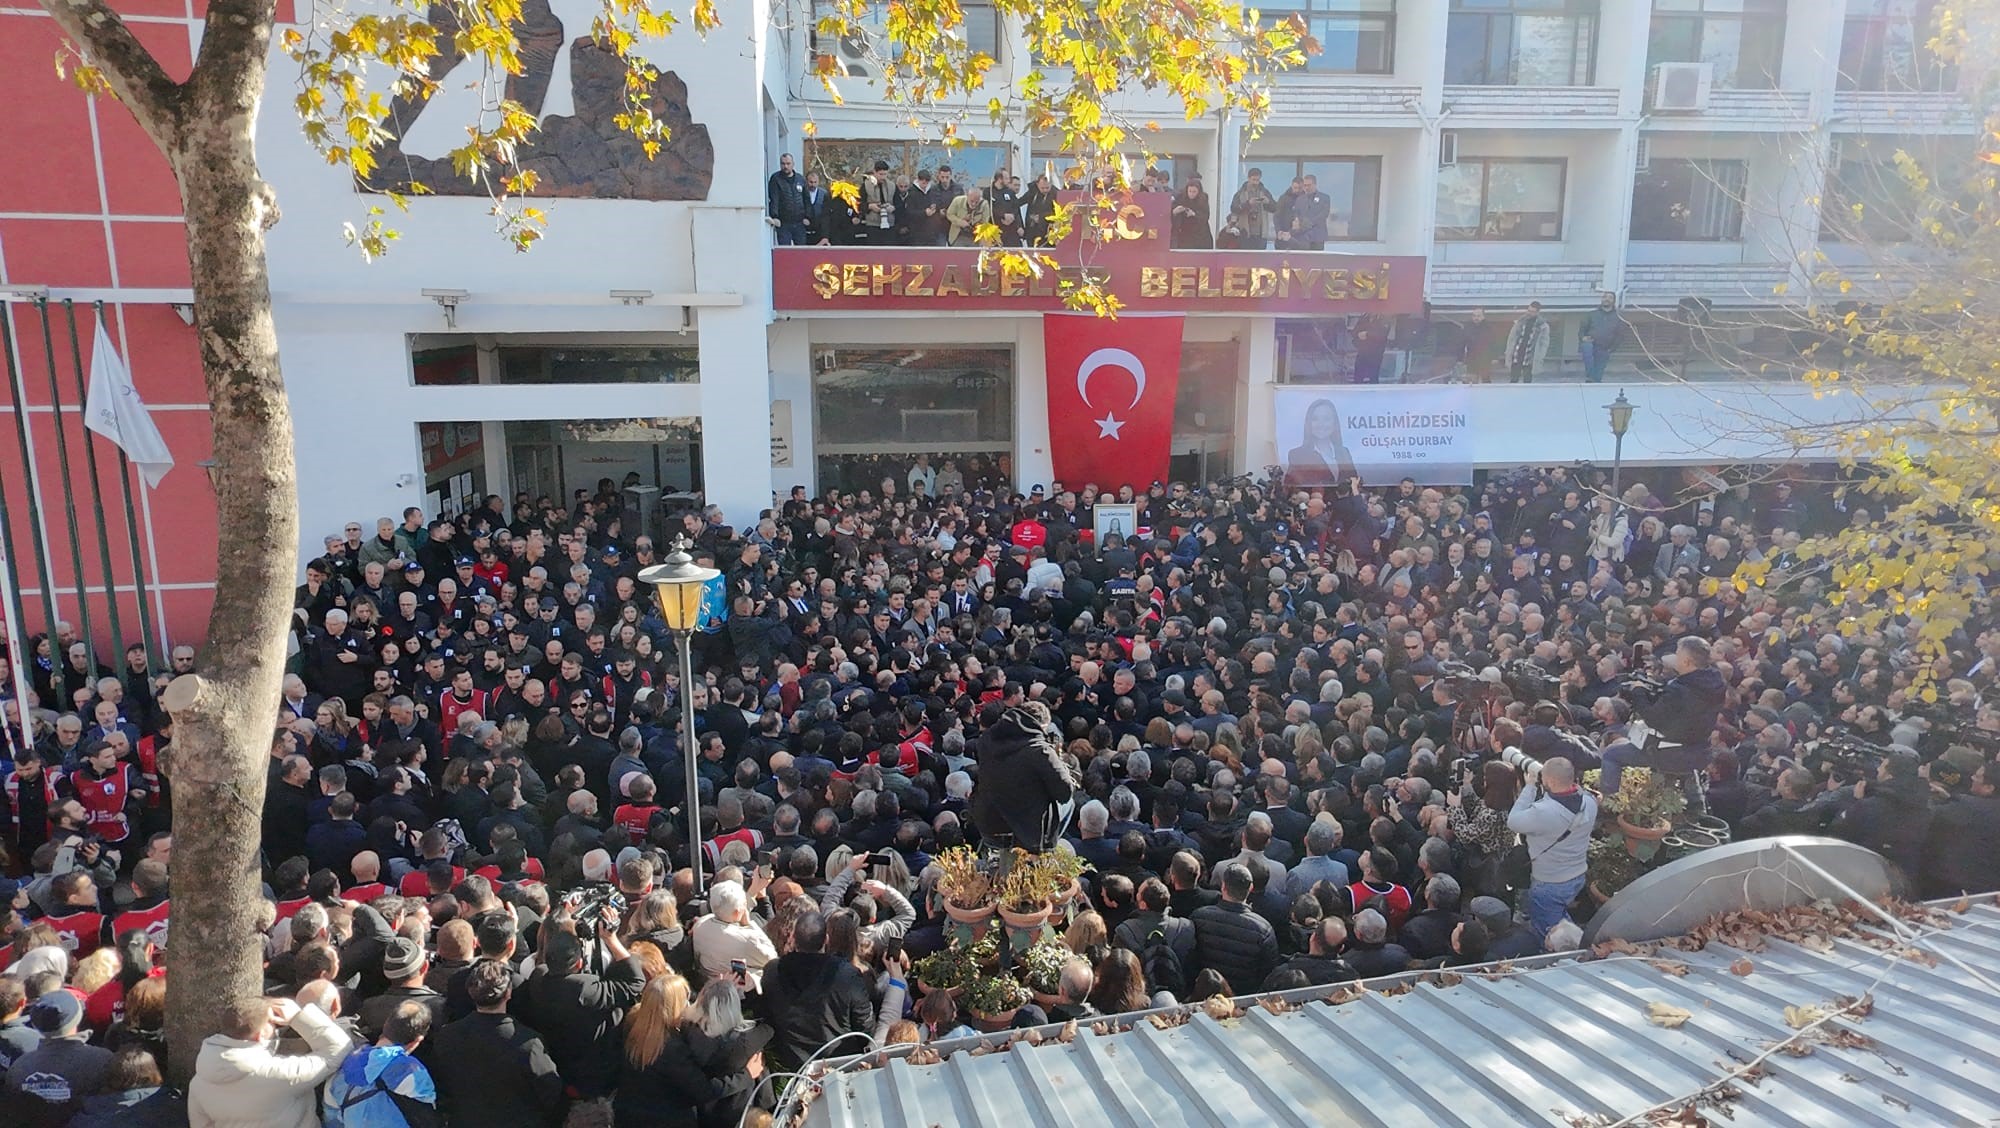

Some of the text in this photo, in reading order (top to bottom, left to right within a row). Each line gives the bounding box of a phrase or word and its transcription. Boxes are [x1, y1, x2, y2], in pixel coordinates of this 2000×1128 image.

[1140, 260, 1390, 300] BELEDİYESİ
[1347, 410, 1466, 429] KALBİMİZDESİN
[1361, 434, 1453, 448] GÜLŞAH DURBAY
